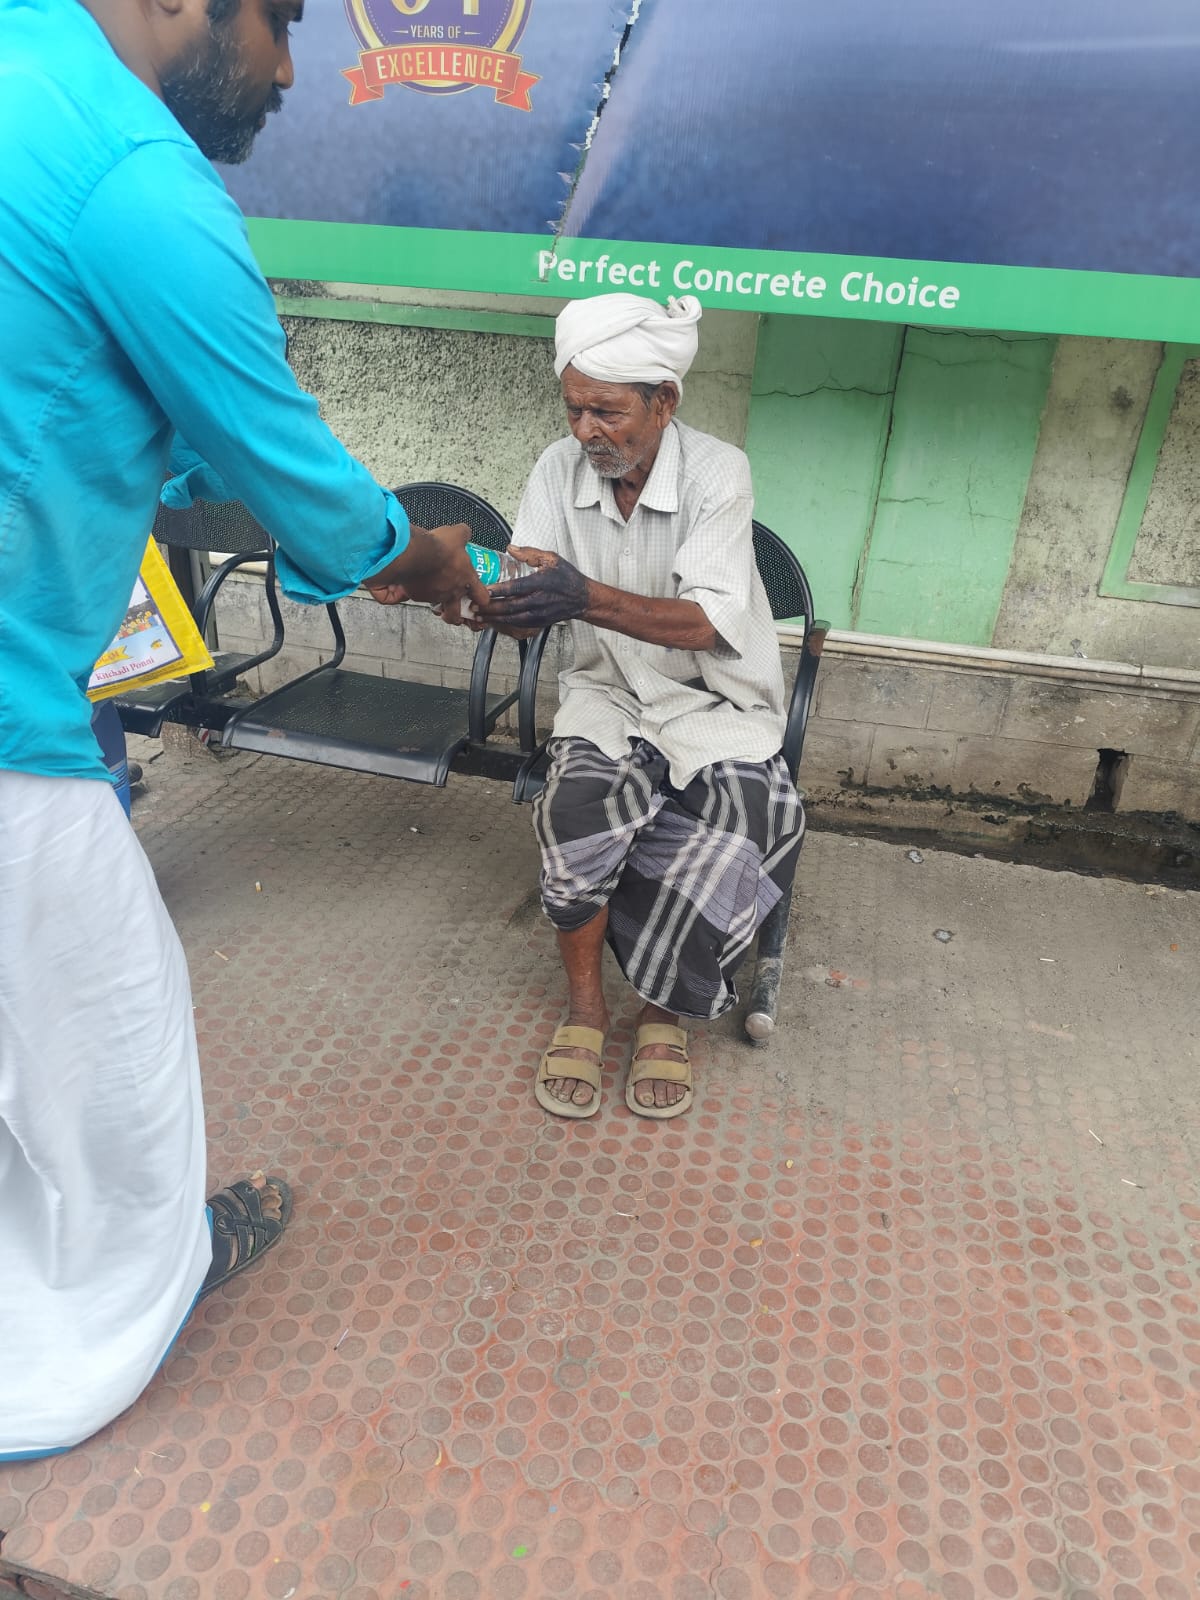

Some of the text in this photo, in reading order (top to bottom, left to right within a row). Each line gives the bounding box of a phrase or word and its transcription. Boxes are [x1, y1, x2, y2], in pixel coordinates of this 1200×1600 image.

[411, 25, 462, 39] YEARS OF
[376, 51, 506, 83] EXCELLENCE
[538, 250, 961, 309] Perfect Concrete Choice
[95, 665, 130, 680] Kitchadi
[130, 655, 155, 671] Ponni
